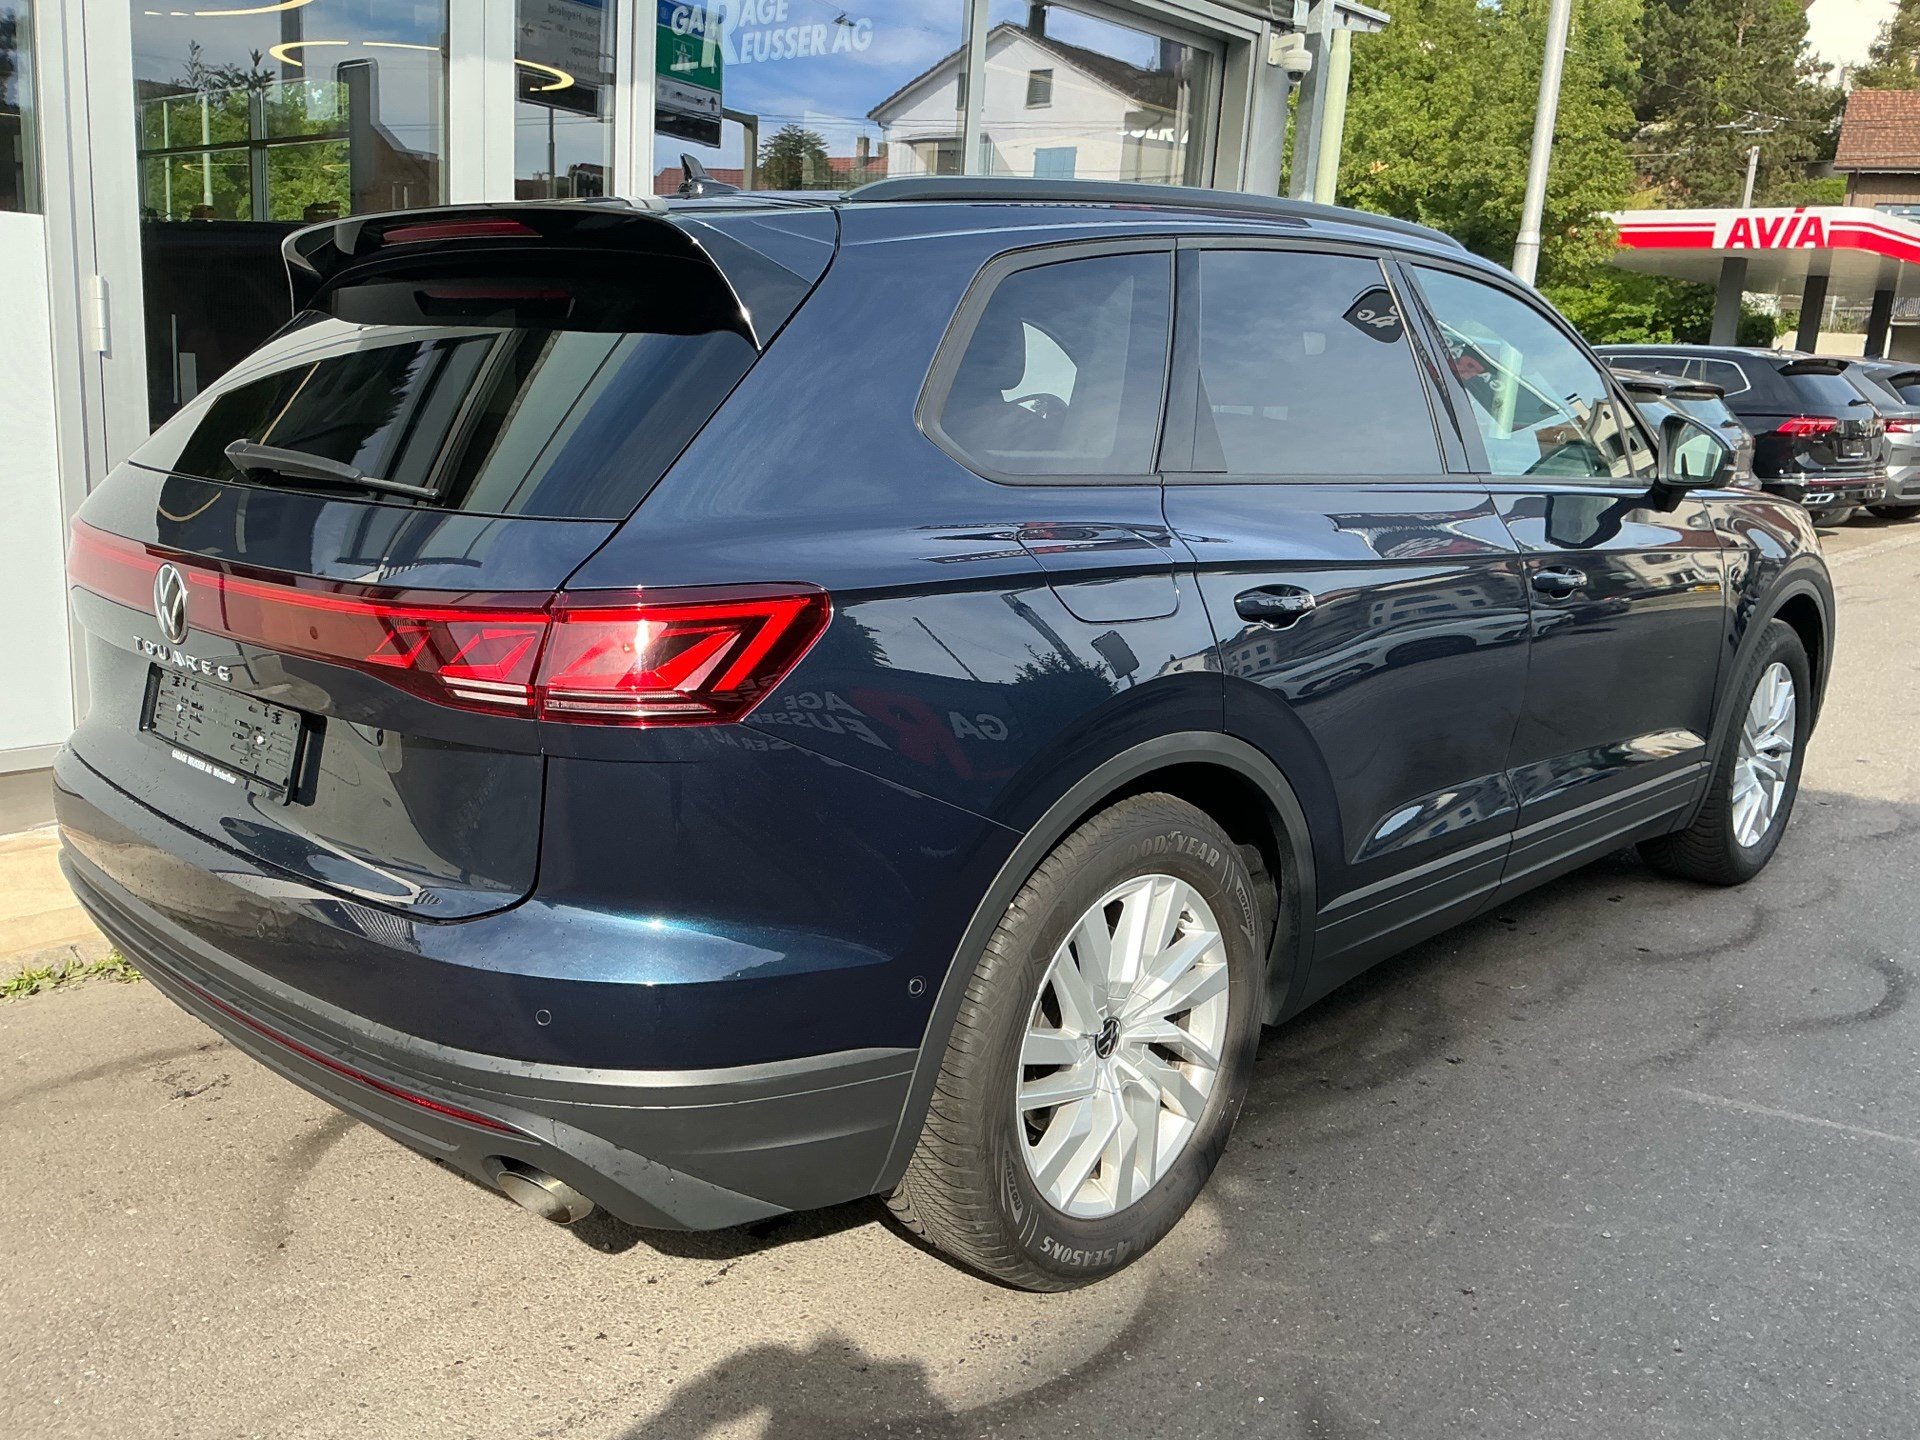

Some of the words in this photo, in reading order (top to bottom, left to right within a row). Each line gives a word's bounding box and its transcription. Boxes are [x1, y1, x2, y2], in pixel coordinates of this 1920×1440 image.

[832, 17, 873, 54] AG
[1725, 207, 1826, 249] AVIA
[133, 635, 233, 682] TOUAREG
[1113, 831, 1220, 868] GOODYEAR
